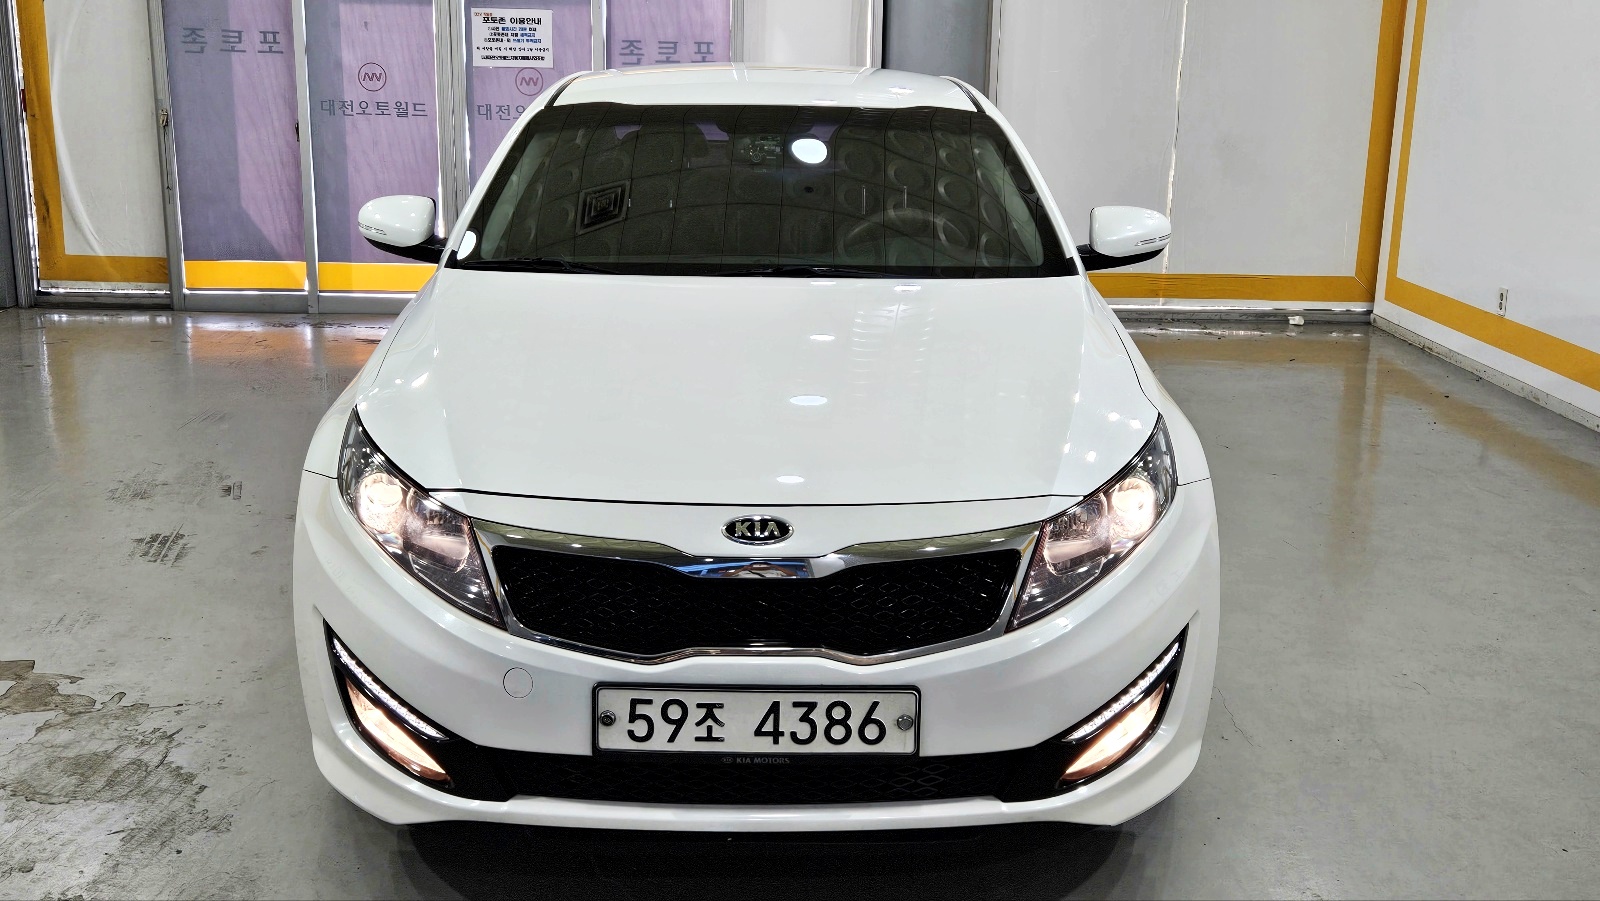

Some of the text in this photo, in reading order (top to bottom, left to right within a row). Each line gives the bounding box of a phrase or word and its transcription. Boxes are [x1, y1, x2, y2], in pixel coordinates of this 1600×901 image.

[482, 16, 542, 25] 포토존 이용안내
[320, 100, 428, 117] 대전오토월드
[735, 521, 781, 537] KIA
[627, 698, 887, 745] 59조 4386
